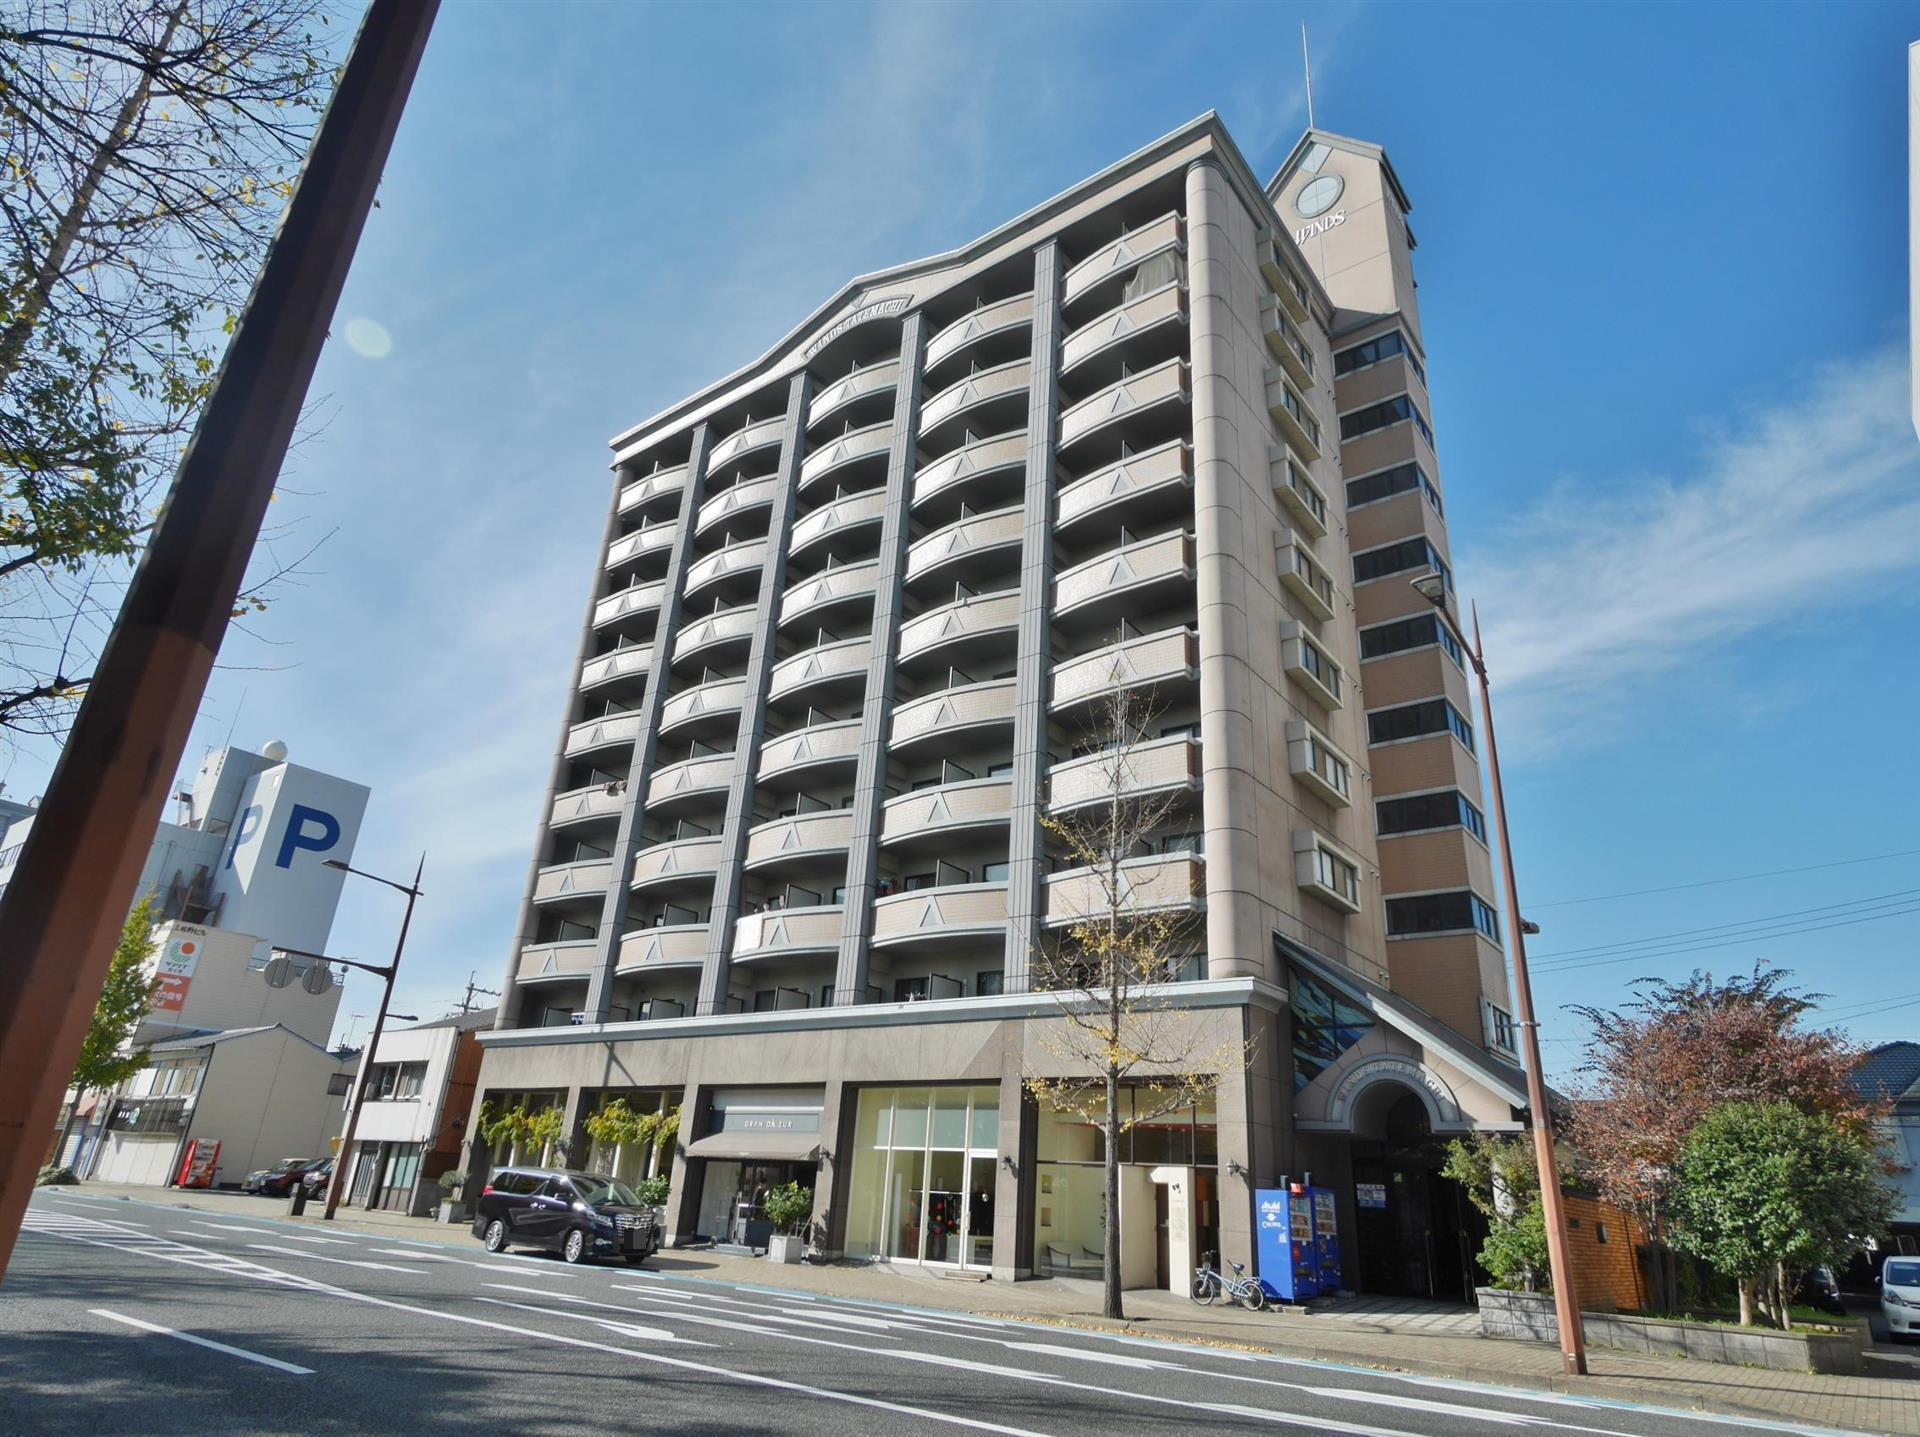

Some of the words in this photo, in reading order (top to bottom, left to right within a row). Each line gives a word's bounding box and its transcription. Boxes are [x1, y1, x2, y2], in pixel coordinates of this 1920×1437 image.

[1295, 209, 1346, 246] WINDS
[808, 322, 844, 355] WINDS
[225, 804, 263, 870] P
[275, 803, 341, 869] P
